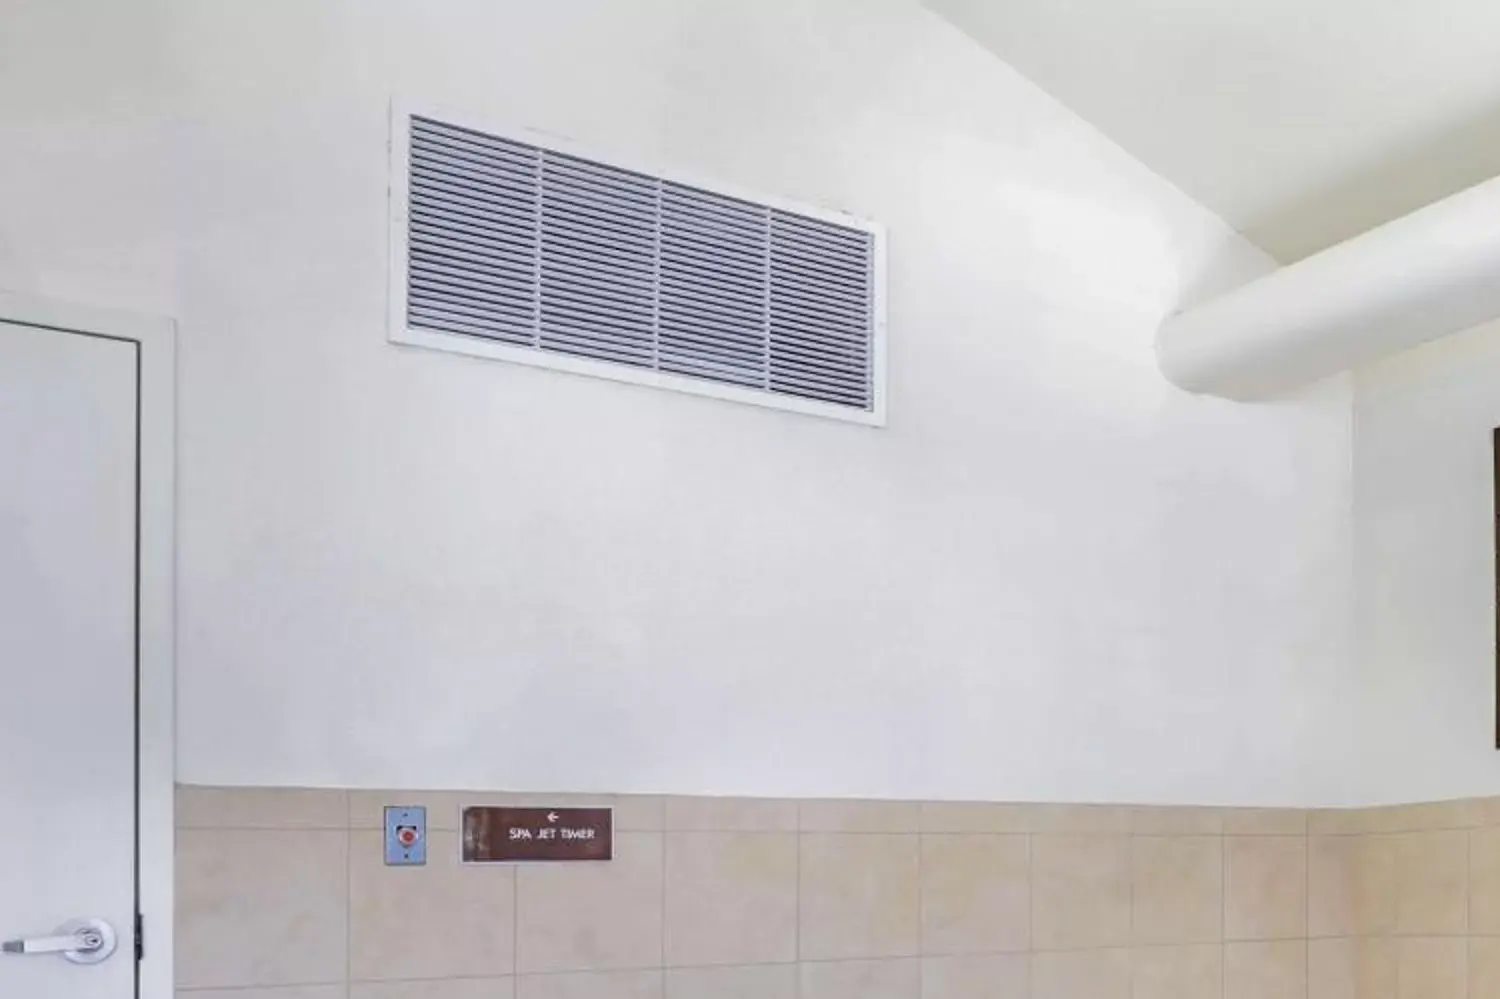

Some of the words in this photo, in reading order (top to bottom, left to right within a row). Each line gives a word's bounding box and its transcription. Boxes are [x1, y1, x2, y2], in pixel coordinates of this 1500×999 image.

[509, 829, 531, 839] SPA
[536, 829, 555, 839] JET
[561, 829, 594, 839] TIMER
